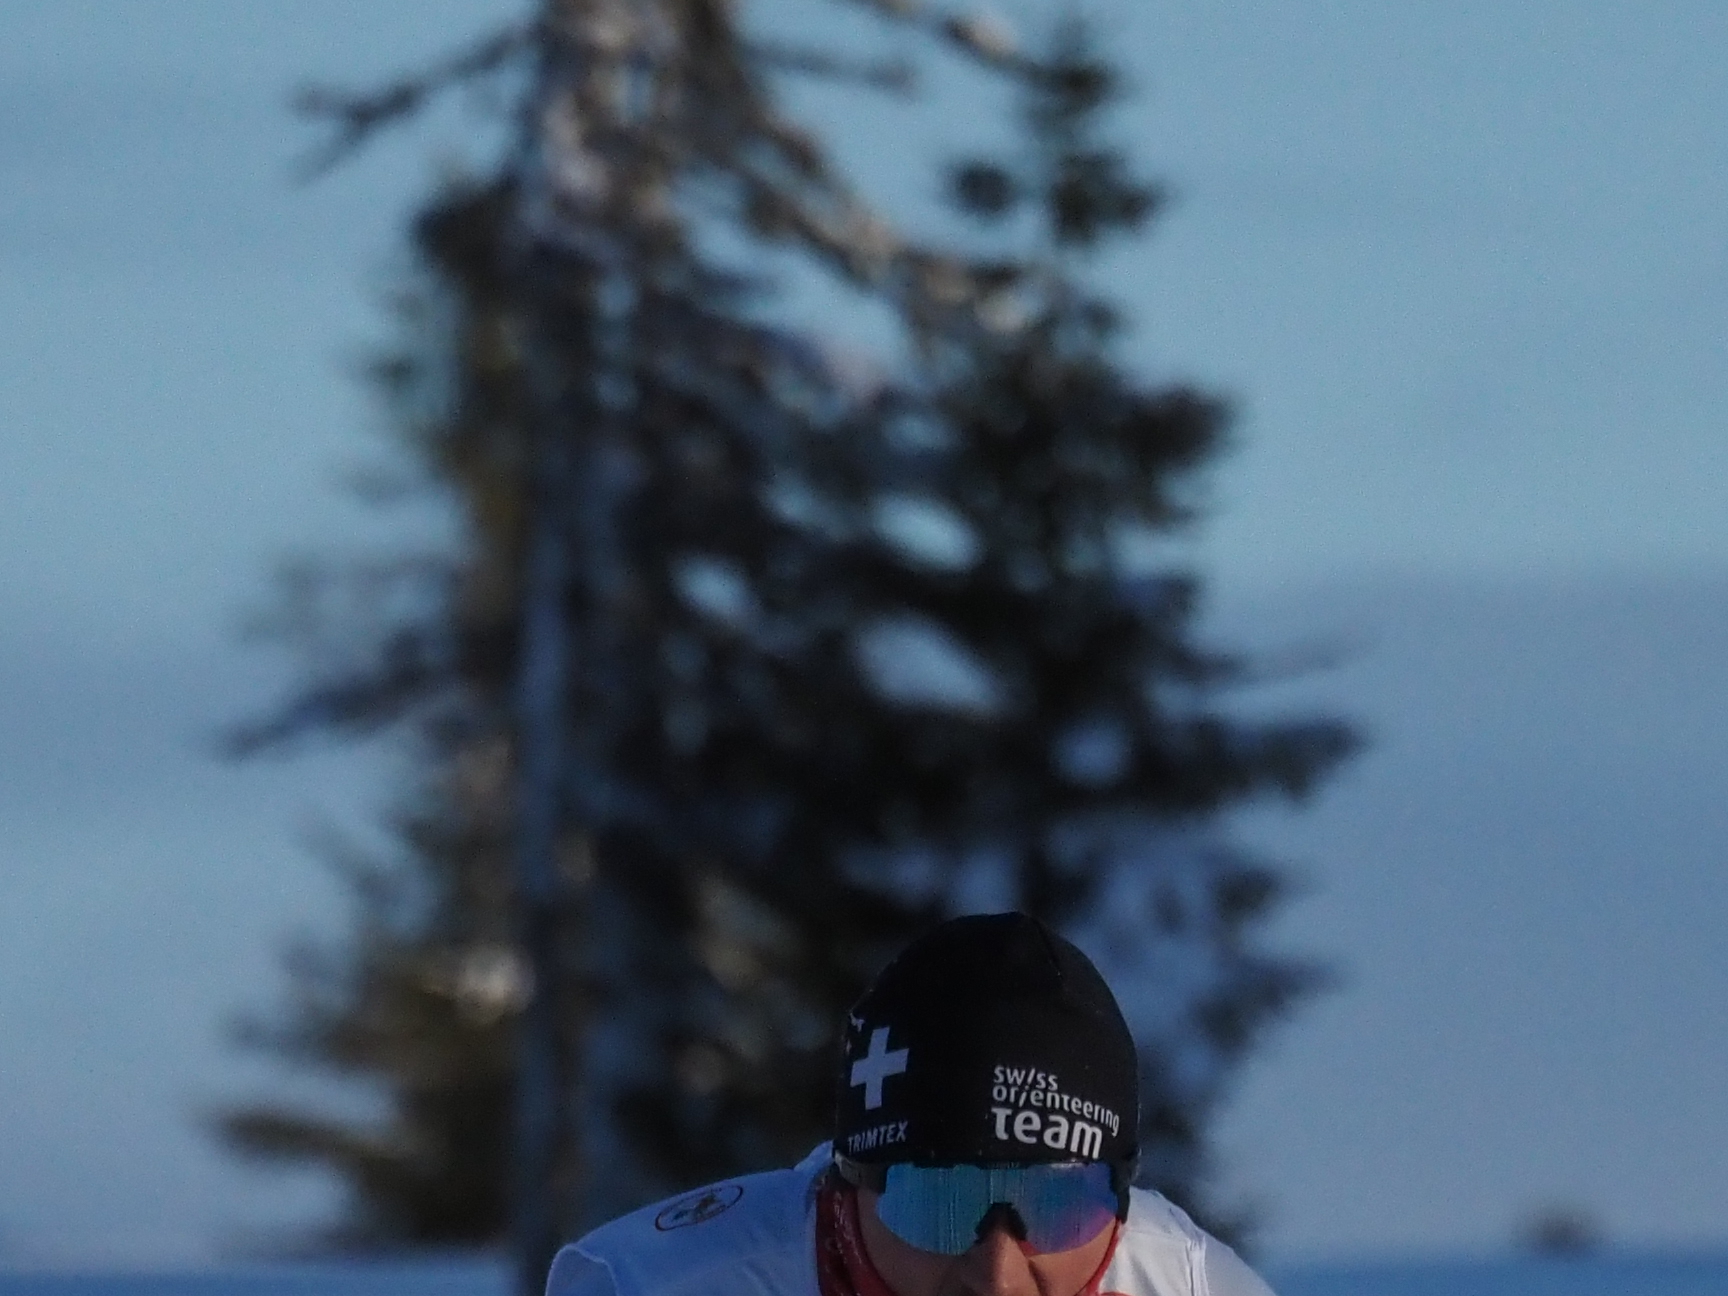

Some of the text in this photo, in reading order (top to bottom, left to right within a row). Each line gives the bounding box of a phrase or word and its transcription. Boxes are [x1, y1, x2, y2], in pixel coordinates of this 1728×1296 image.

[993, 1064, 1059, 1091] swiss
[991, 1106, 1103, 1160] team
[992, 1084, 1120, 1138] orienteering
[847, 1120, 909, 1156] TRIMTEX
